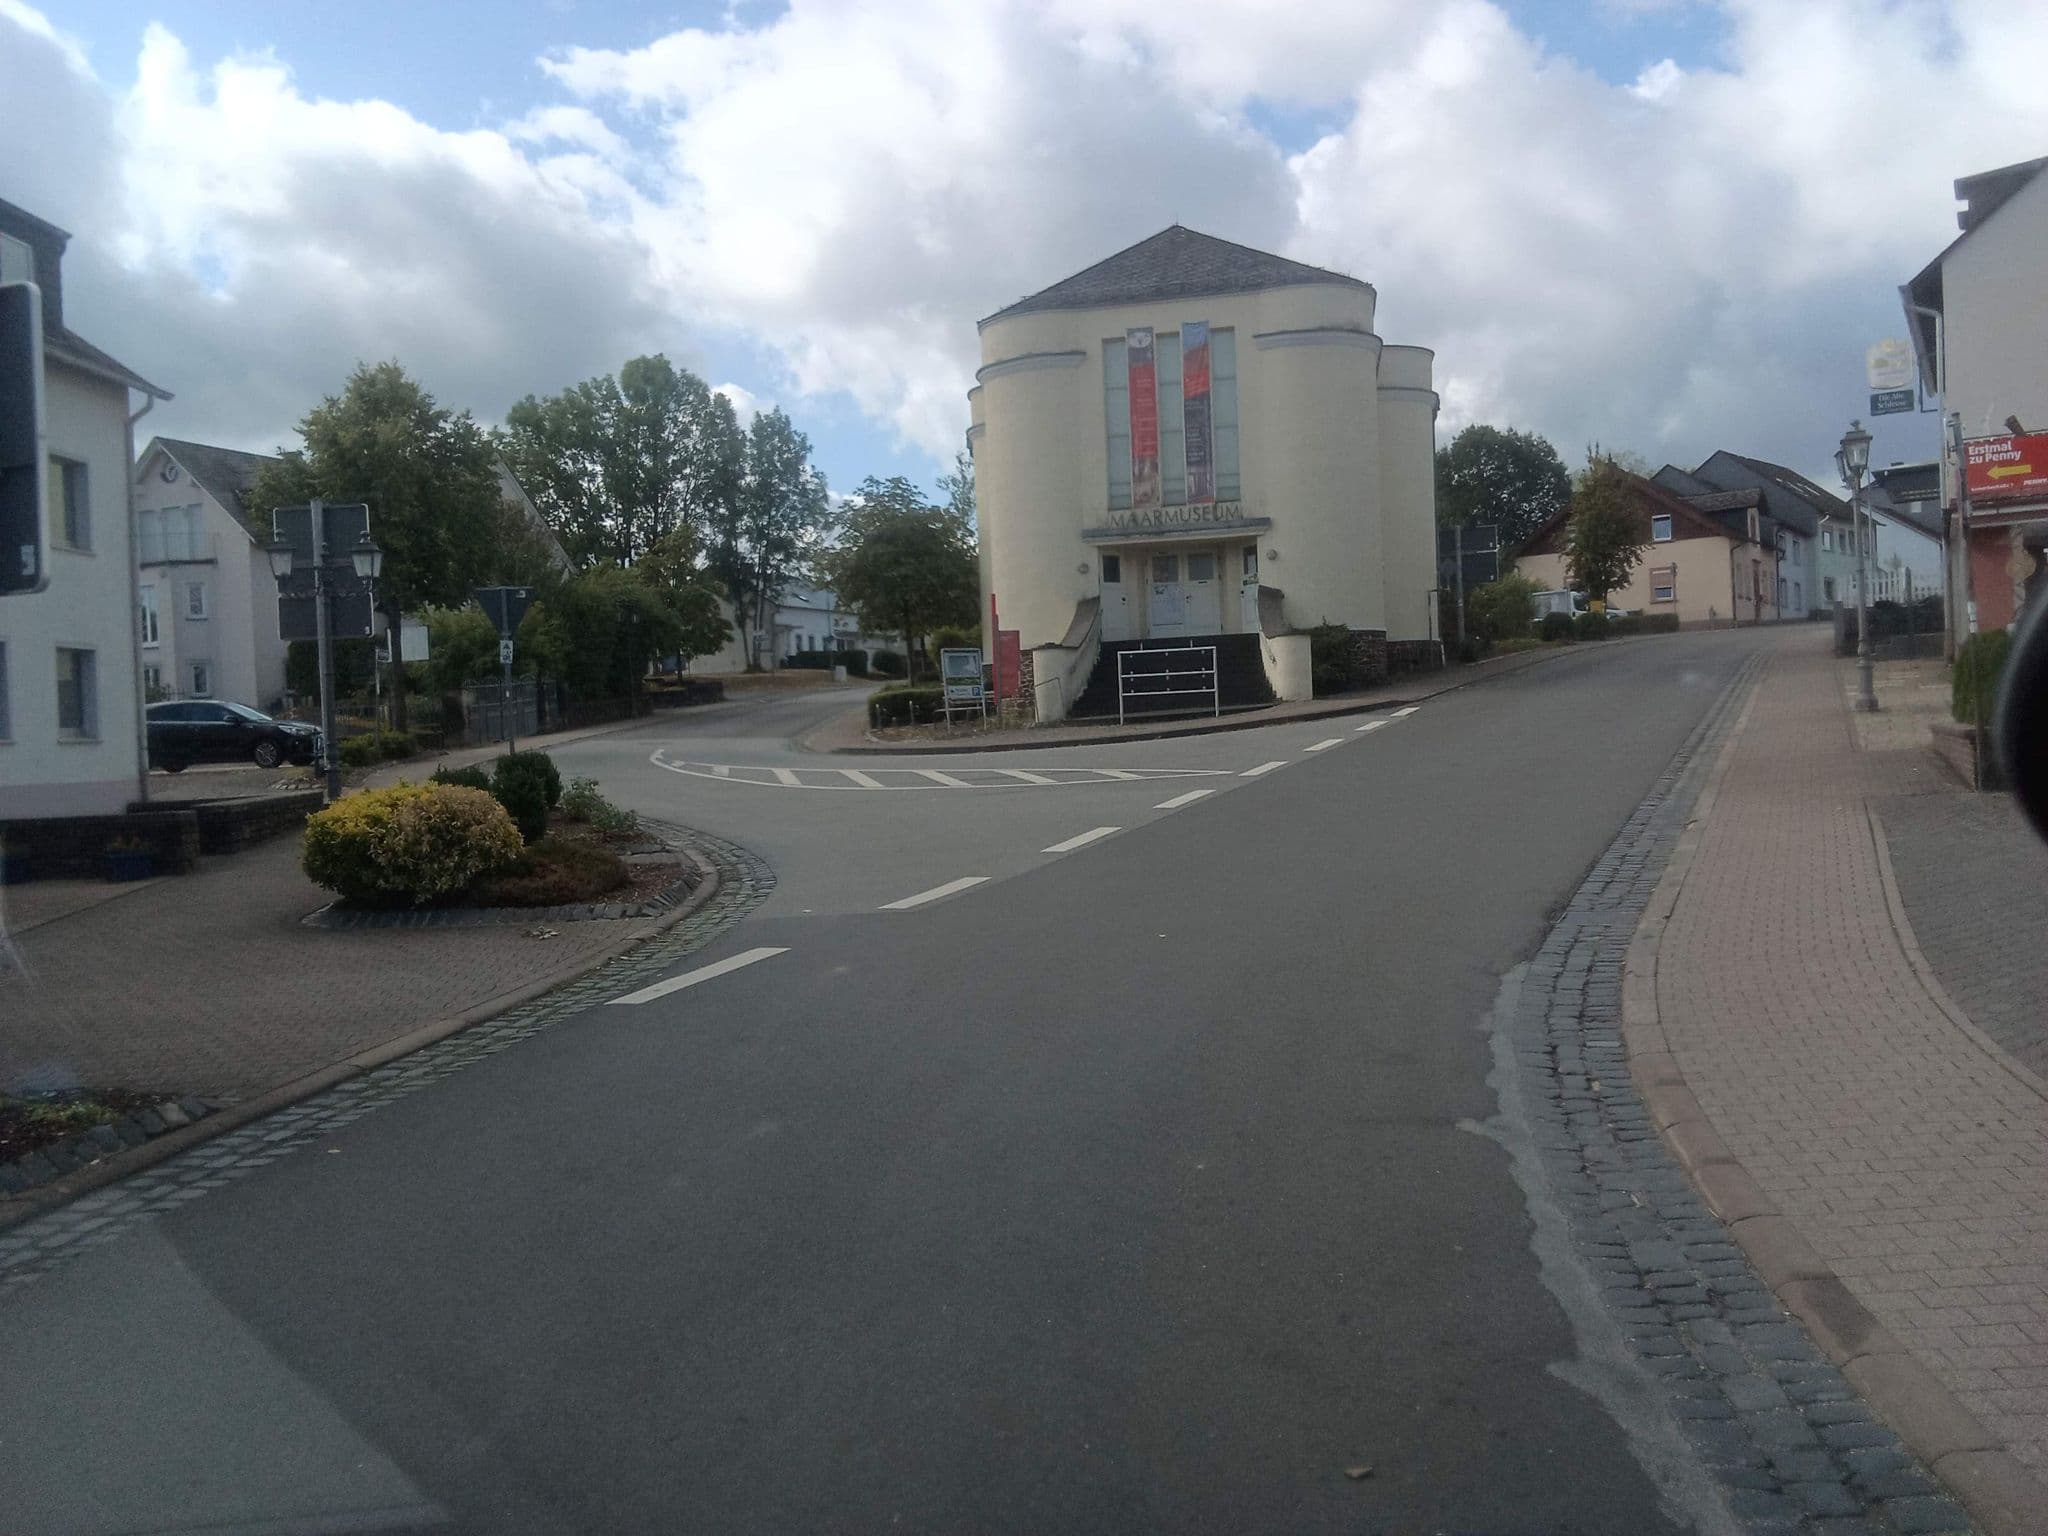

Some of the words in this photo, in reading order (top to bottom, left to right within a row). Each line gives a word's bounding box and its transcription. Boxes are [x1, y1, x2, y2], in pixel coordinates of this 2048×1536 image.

[1968, 441, 2012, 456] Erstmal
[1968, 456, 1983, 465] zu
[1985, 450, 2022, 463] Penny
[1110, 503, 1244, 528] MAARMUSEUM
